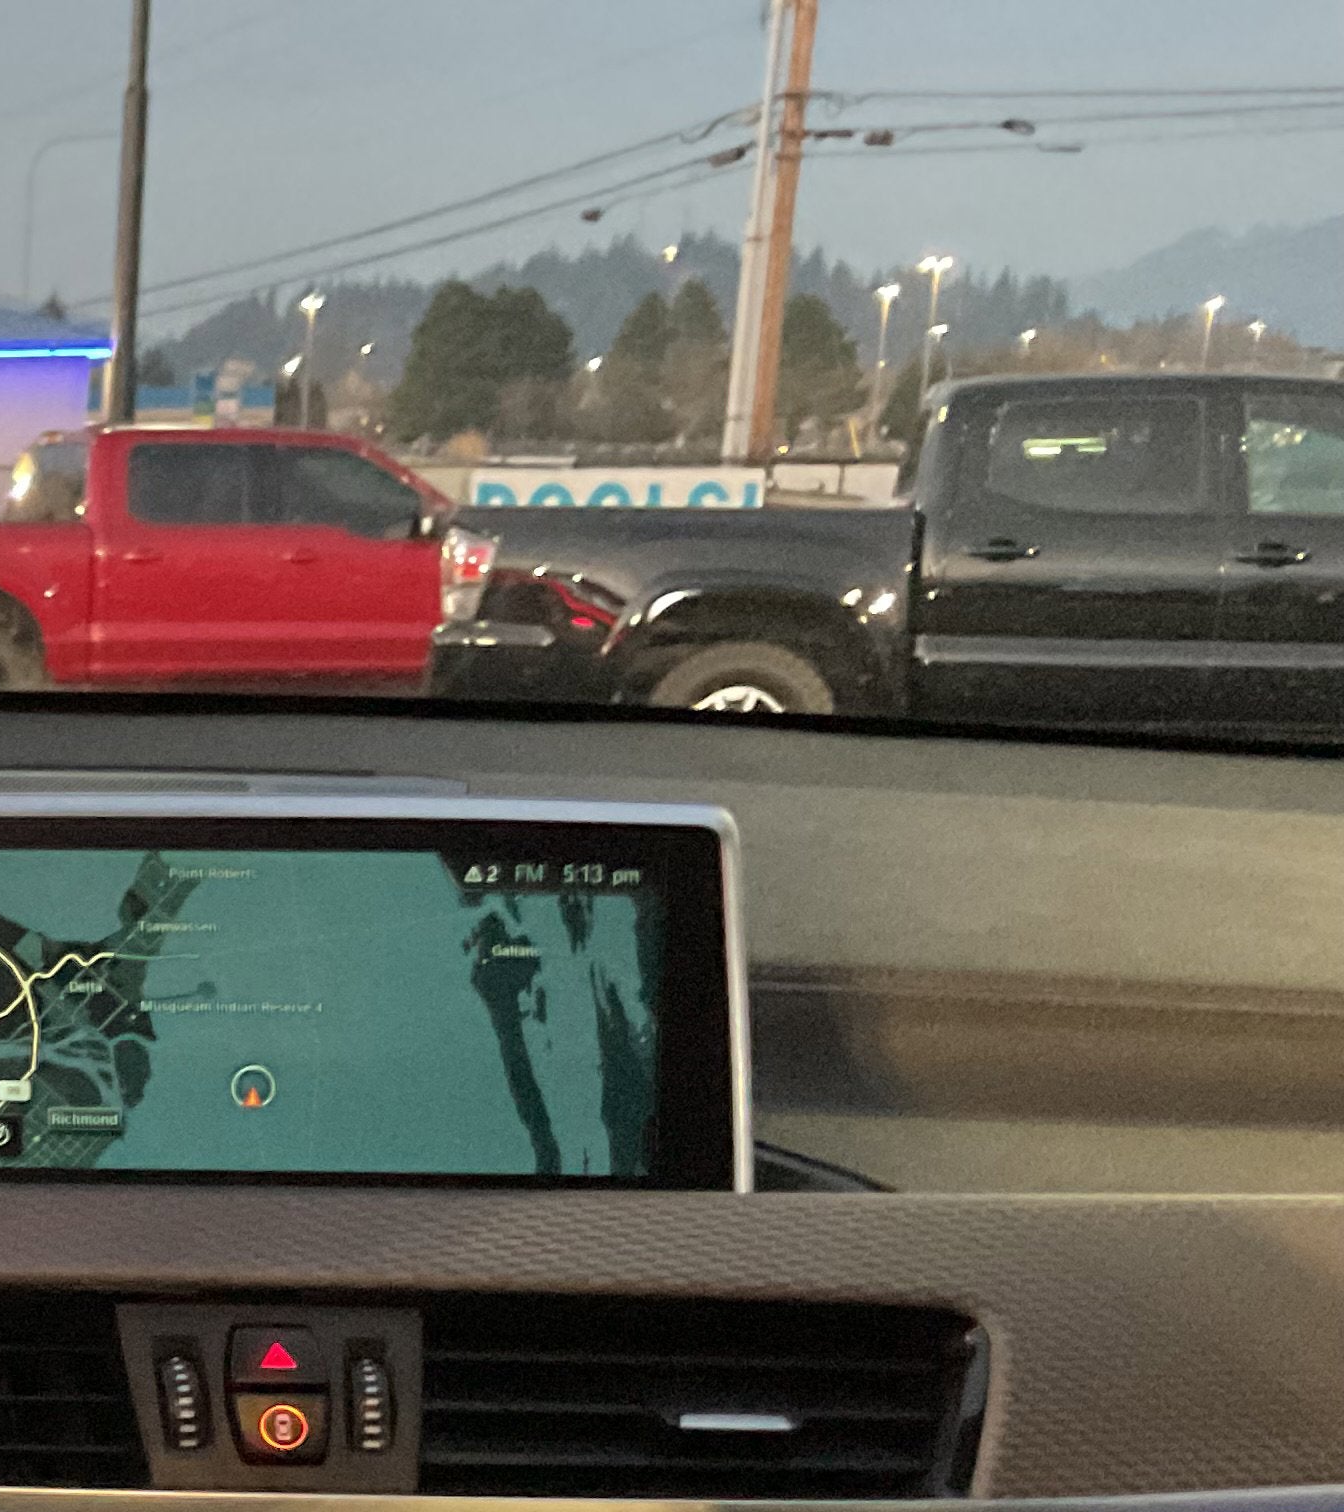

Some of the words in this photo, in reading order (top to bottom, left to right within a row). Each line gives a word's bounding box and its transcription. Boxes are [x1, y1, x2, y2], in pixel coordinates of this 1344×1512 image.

[486, 865, 498, 883] 2
[514, 864, 544, 883] FM
[563, 864, 603, 884] 5:13
[612, 869, 641, 887] pm
[51, 1113, 119, 1126] Richmond
